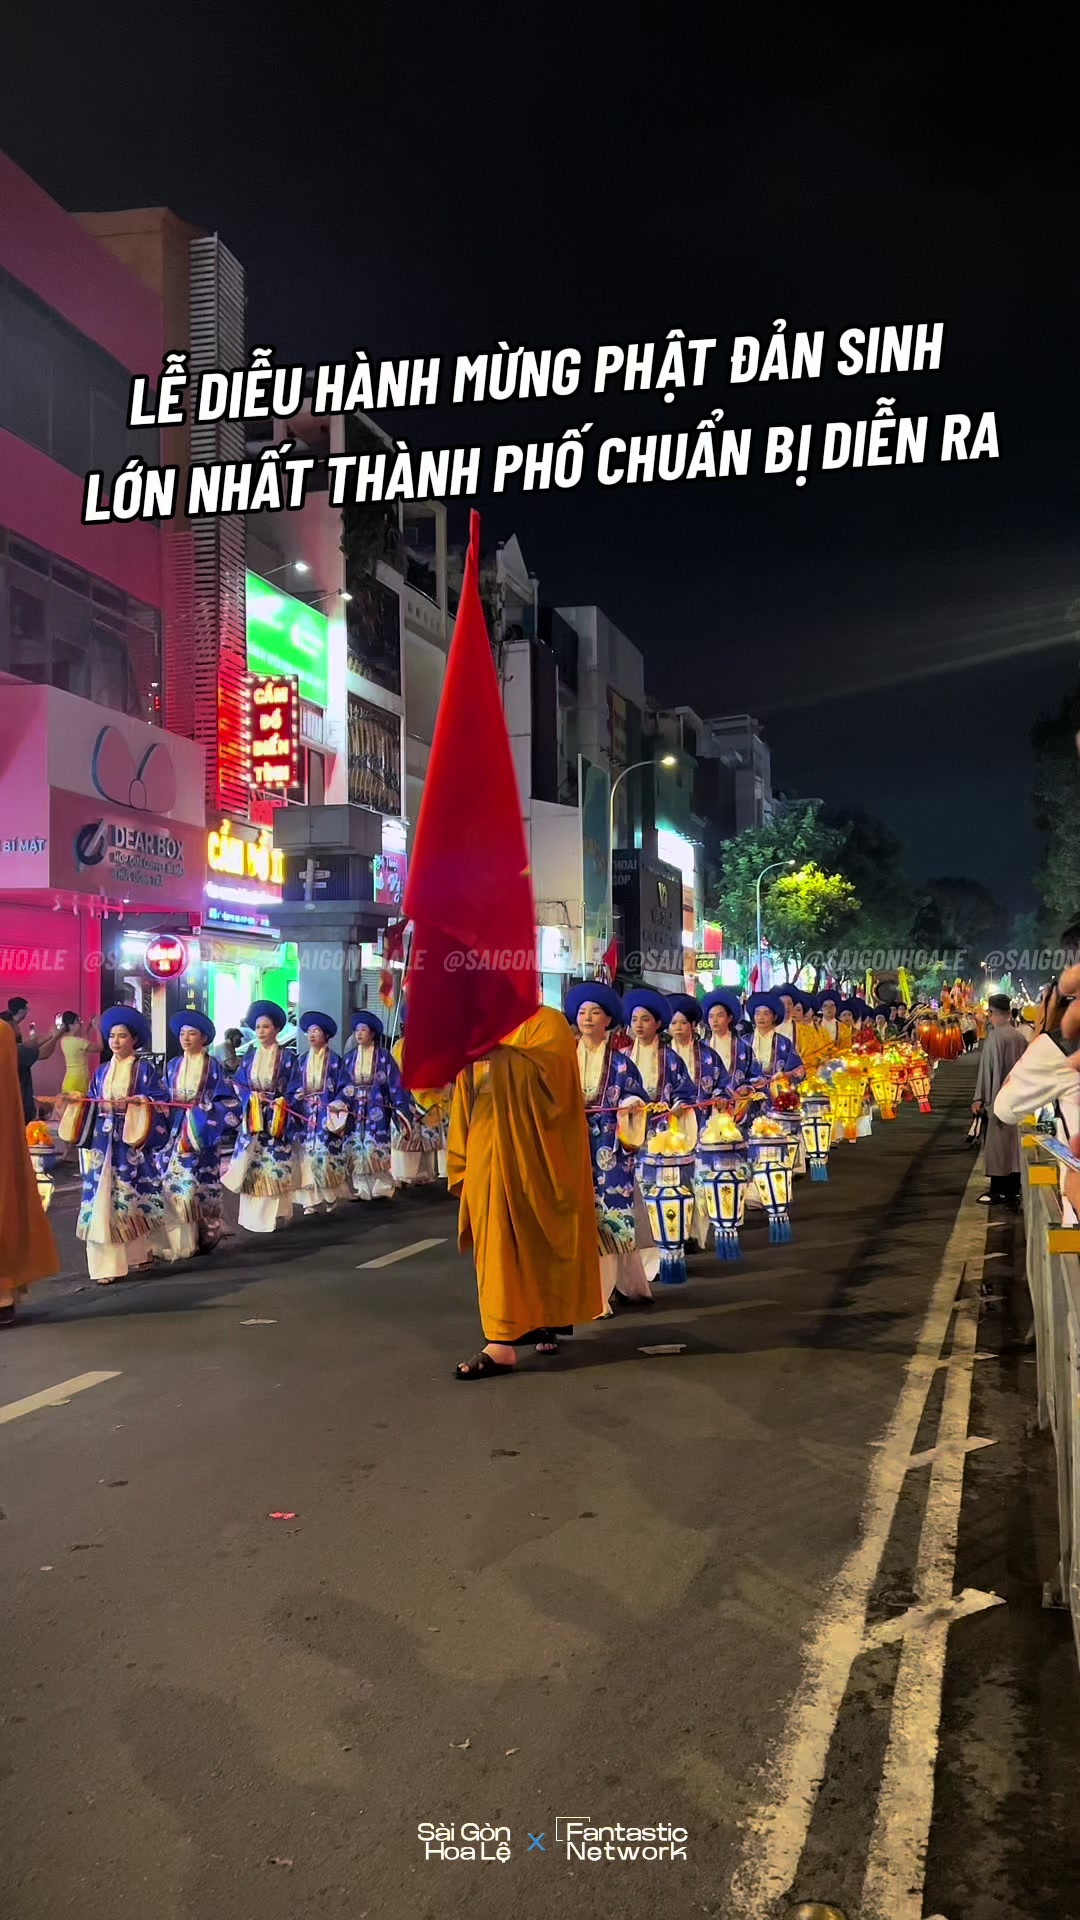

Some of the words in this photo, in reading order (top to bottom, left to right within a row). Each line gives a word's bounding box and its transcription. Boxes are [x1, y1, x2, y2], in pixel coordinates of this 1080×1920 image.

[114, 826, 154, 854] DEAR
[157, 836, 185, 860] BOX
[696, 960, 714, 969] 664
